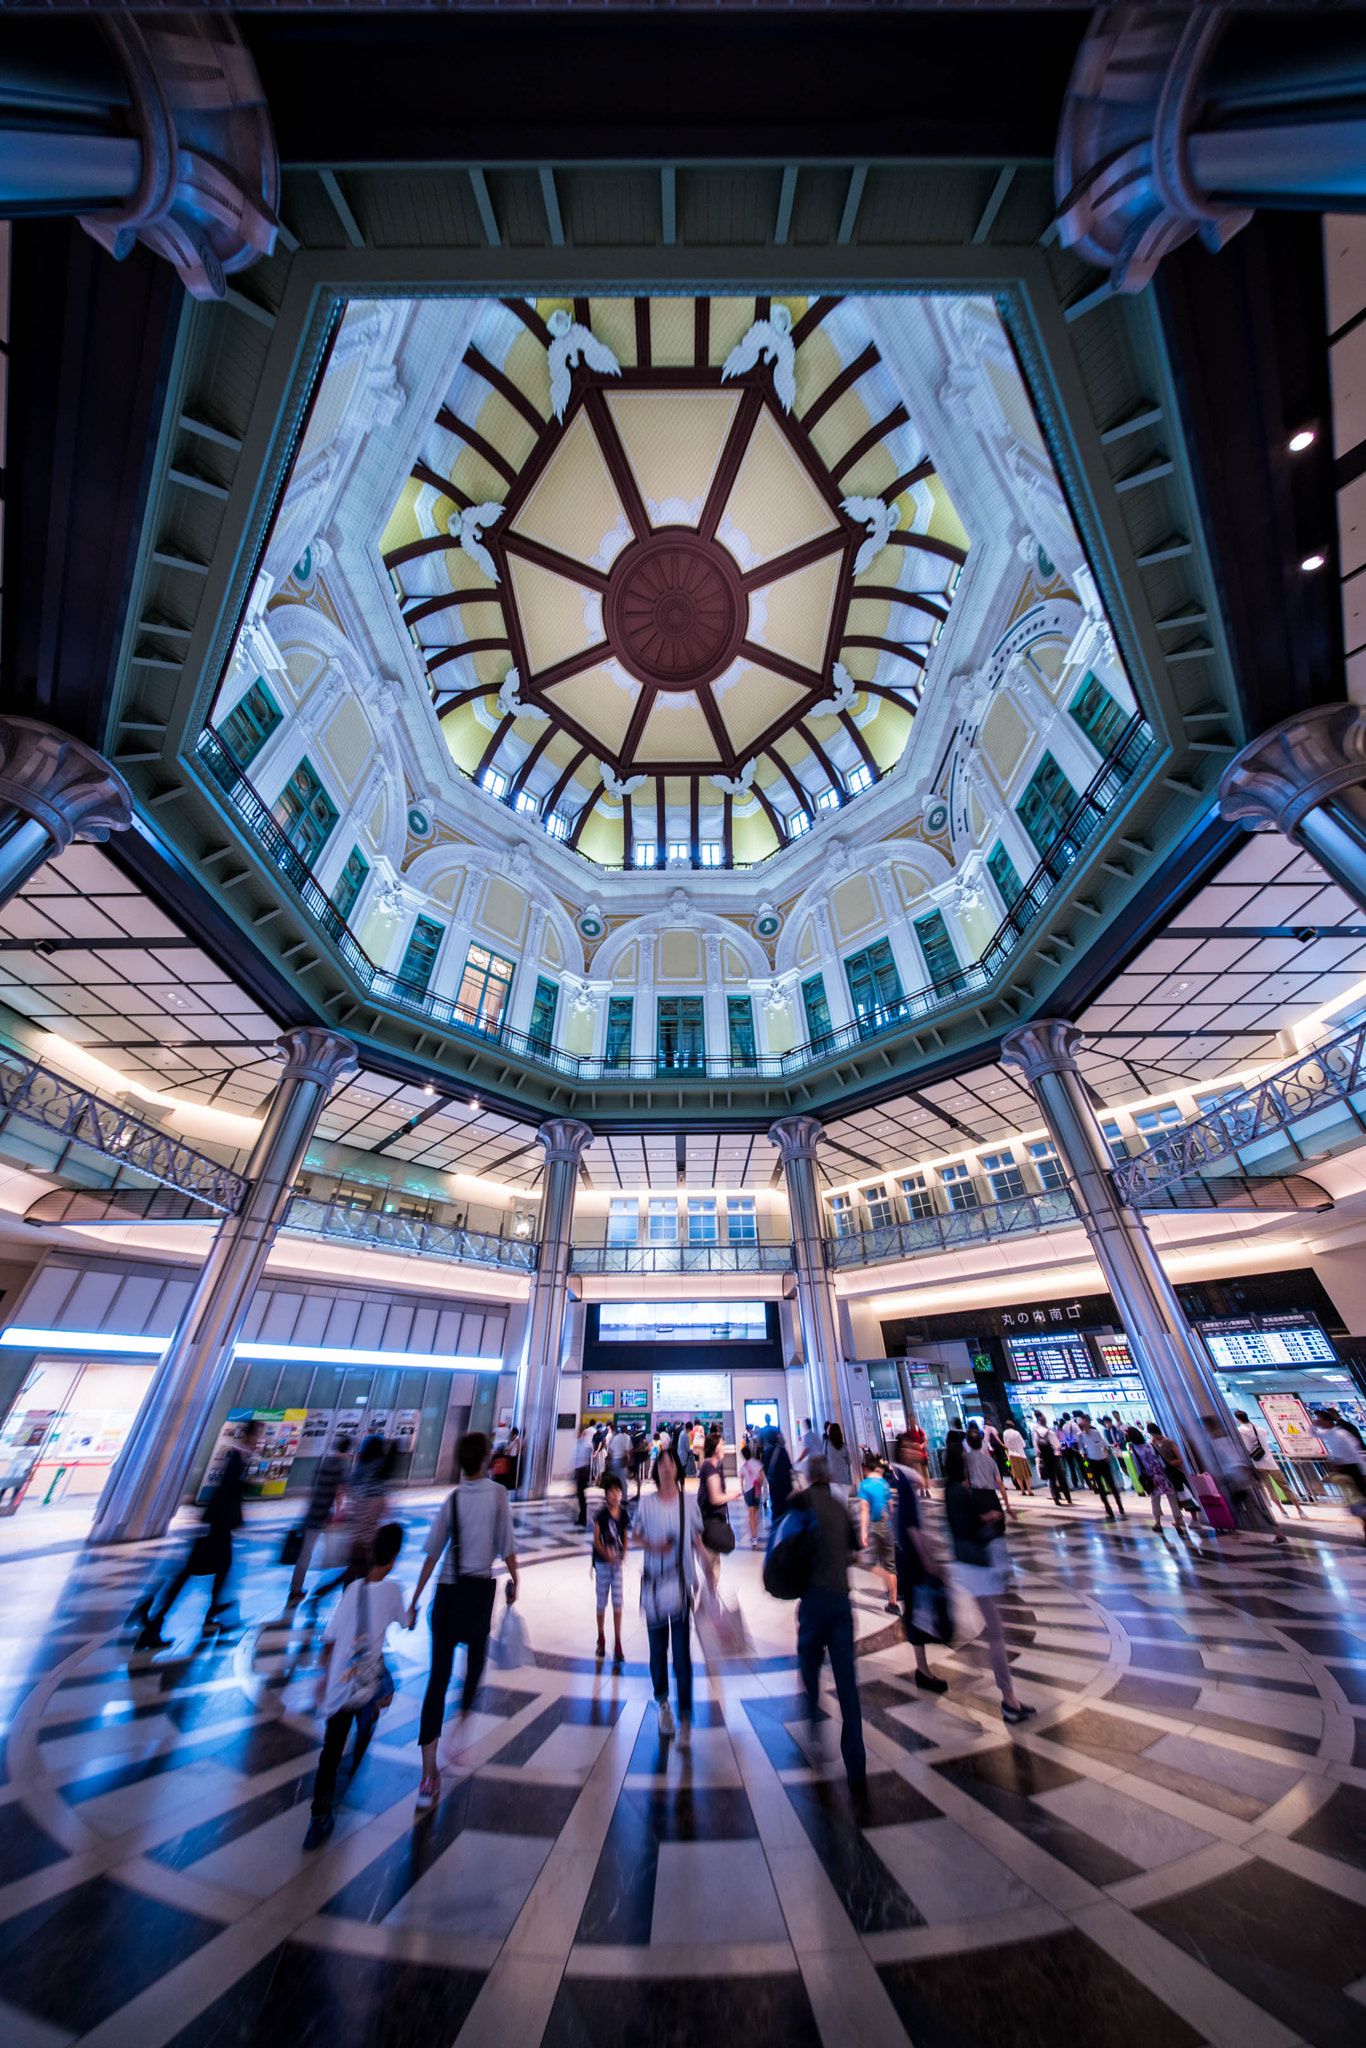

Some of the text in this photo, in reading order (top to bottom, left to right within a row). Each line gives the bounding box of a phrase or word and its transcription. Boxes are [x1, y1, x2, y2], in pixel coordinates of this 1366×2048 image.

[1001, 1307, 1080, 1326] 丸の内南口
